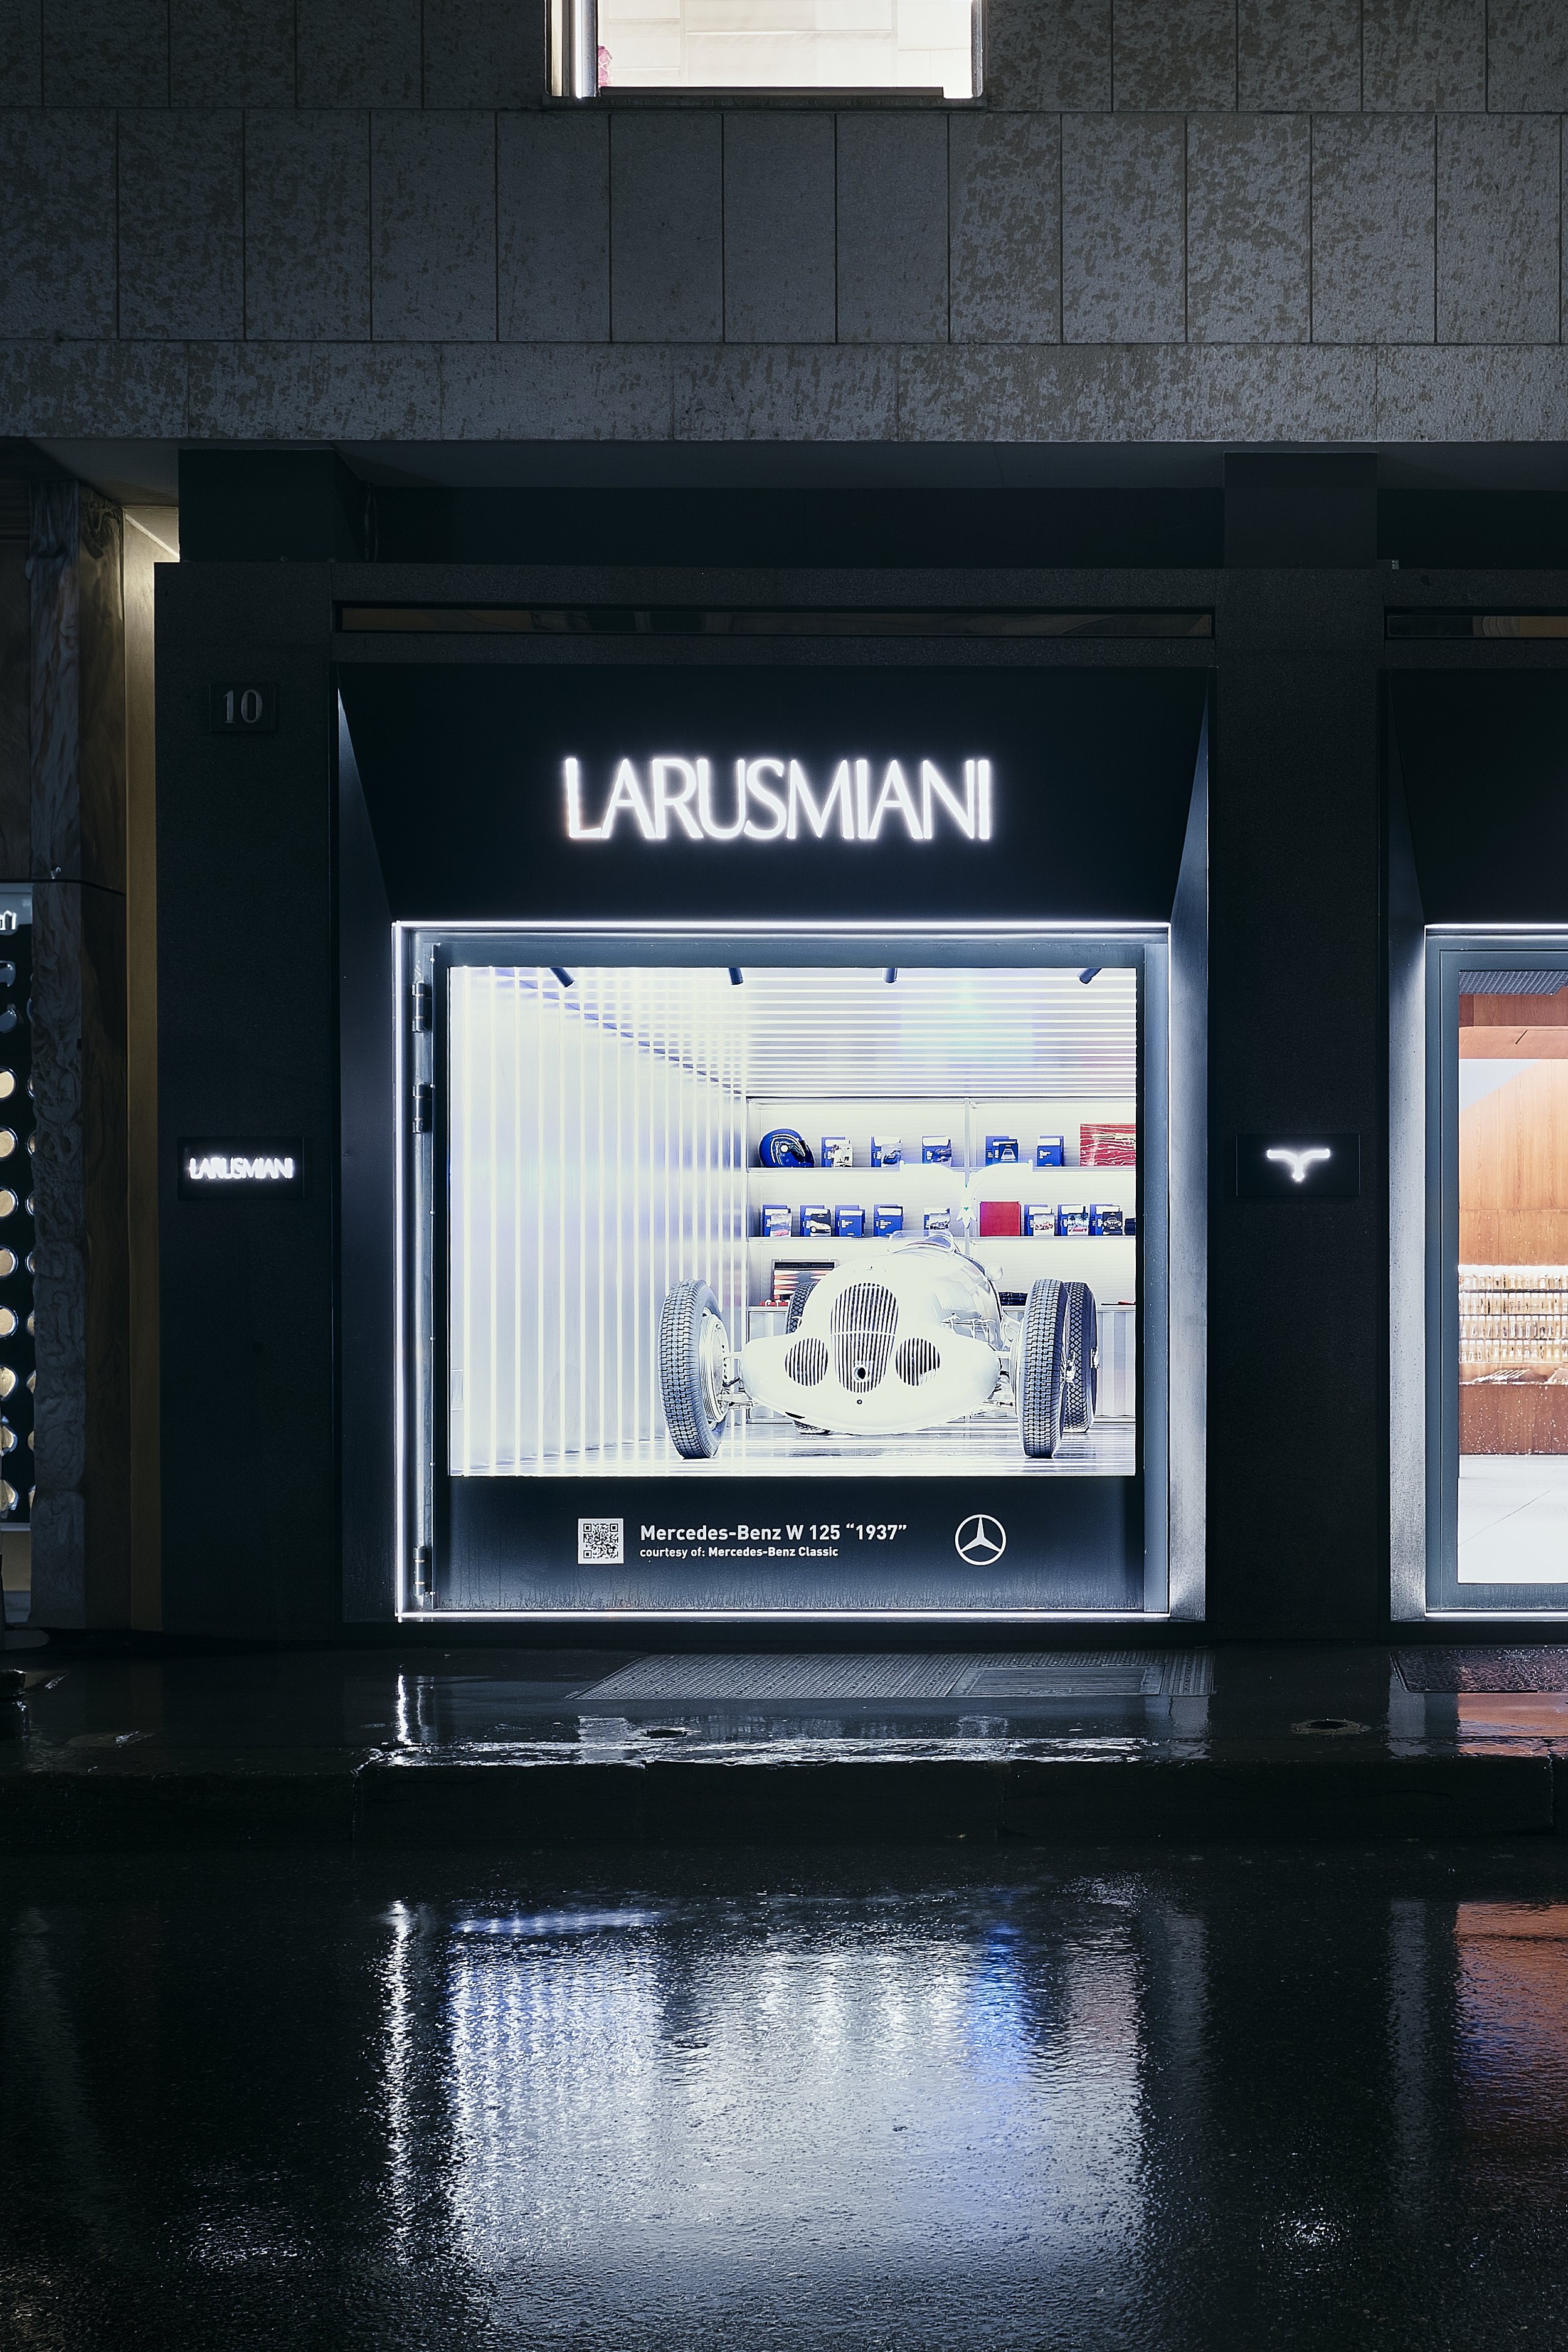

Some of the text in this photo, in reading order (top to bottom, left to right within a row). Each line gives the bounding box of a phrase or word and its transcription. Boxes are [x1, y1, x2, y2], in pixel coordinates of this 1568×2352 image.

[223, 689, 263, 724] 10
[564, 756, 992, 840] LARUSMIANI
[640, 1525, 781, 1541] Mercedes-Benz
[785, 1524, 805, 1540] W
[809, 1524, 840, 1540] 125
[640, 1546, 839, 1559] courtesy of: Mercedes-Benz Classic
